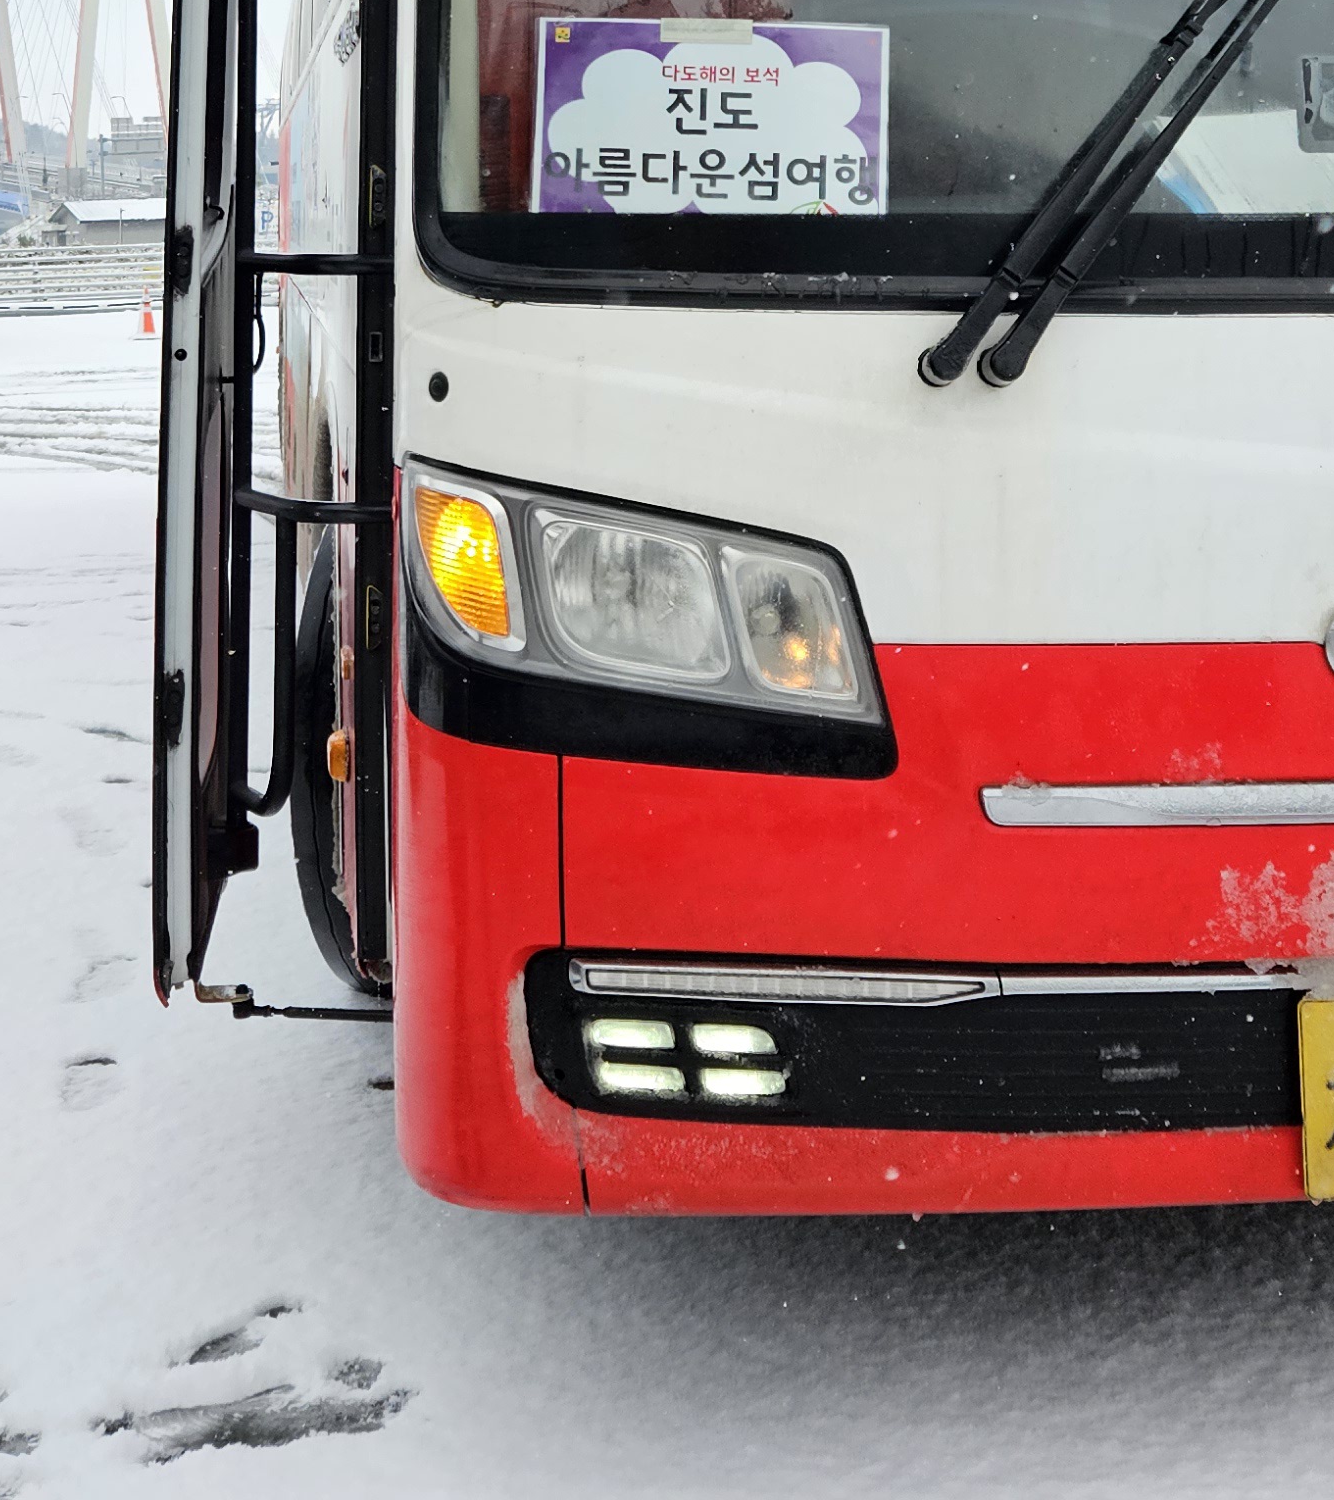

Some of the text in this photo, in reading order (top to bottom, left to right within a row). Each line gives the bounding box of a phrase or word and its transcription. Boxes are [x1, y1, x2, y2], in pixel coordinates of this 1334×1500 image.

[661, 64, 781, 87] 다도해의 보석
[665, 87, 759, 136] 진도
[544, 146, 876, 206] 아름다운섬여행
